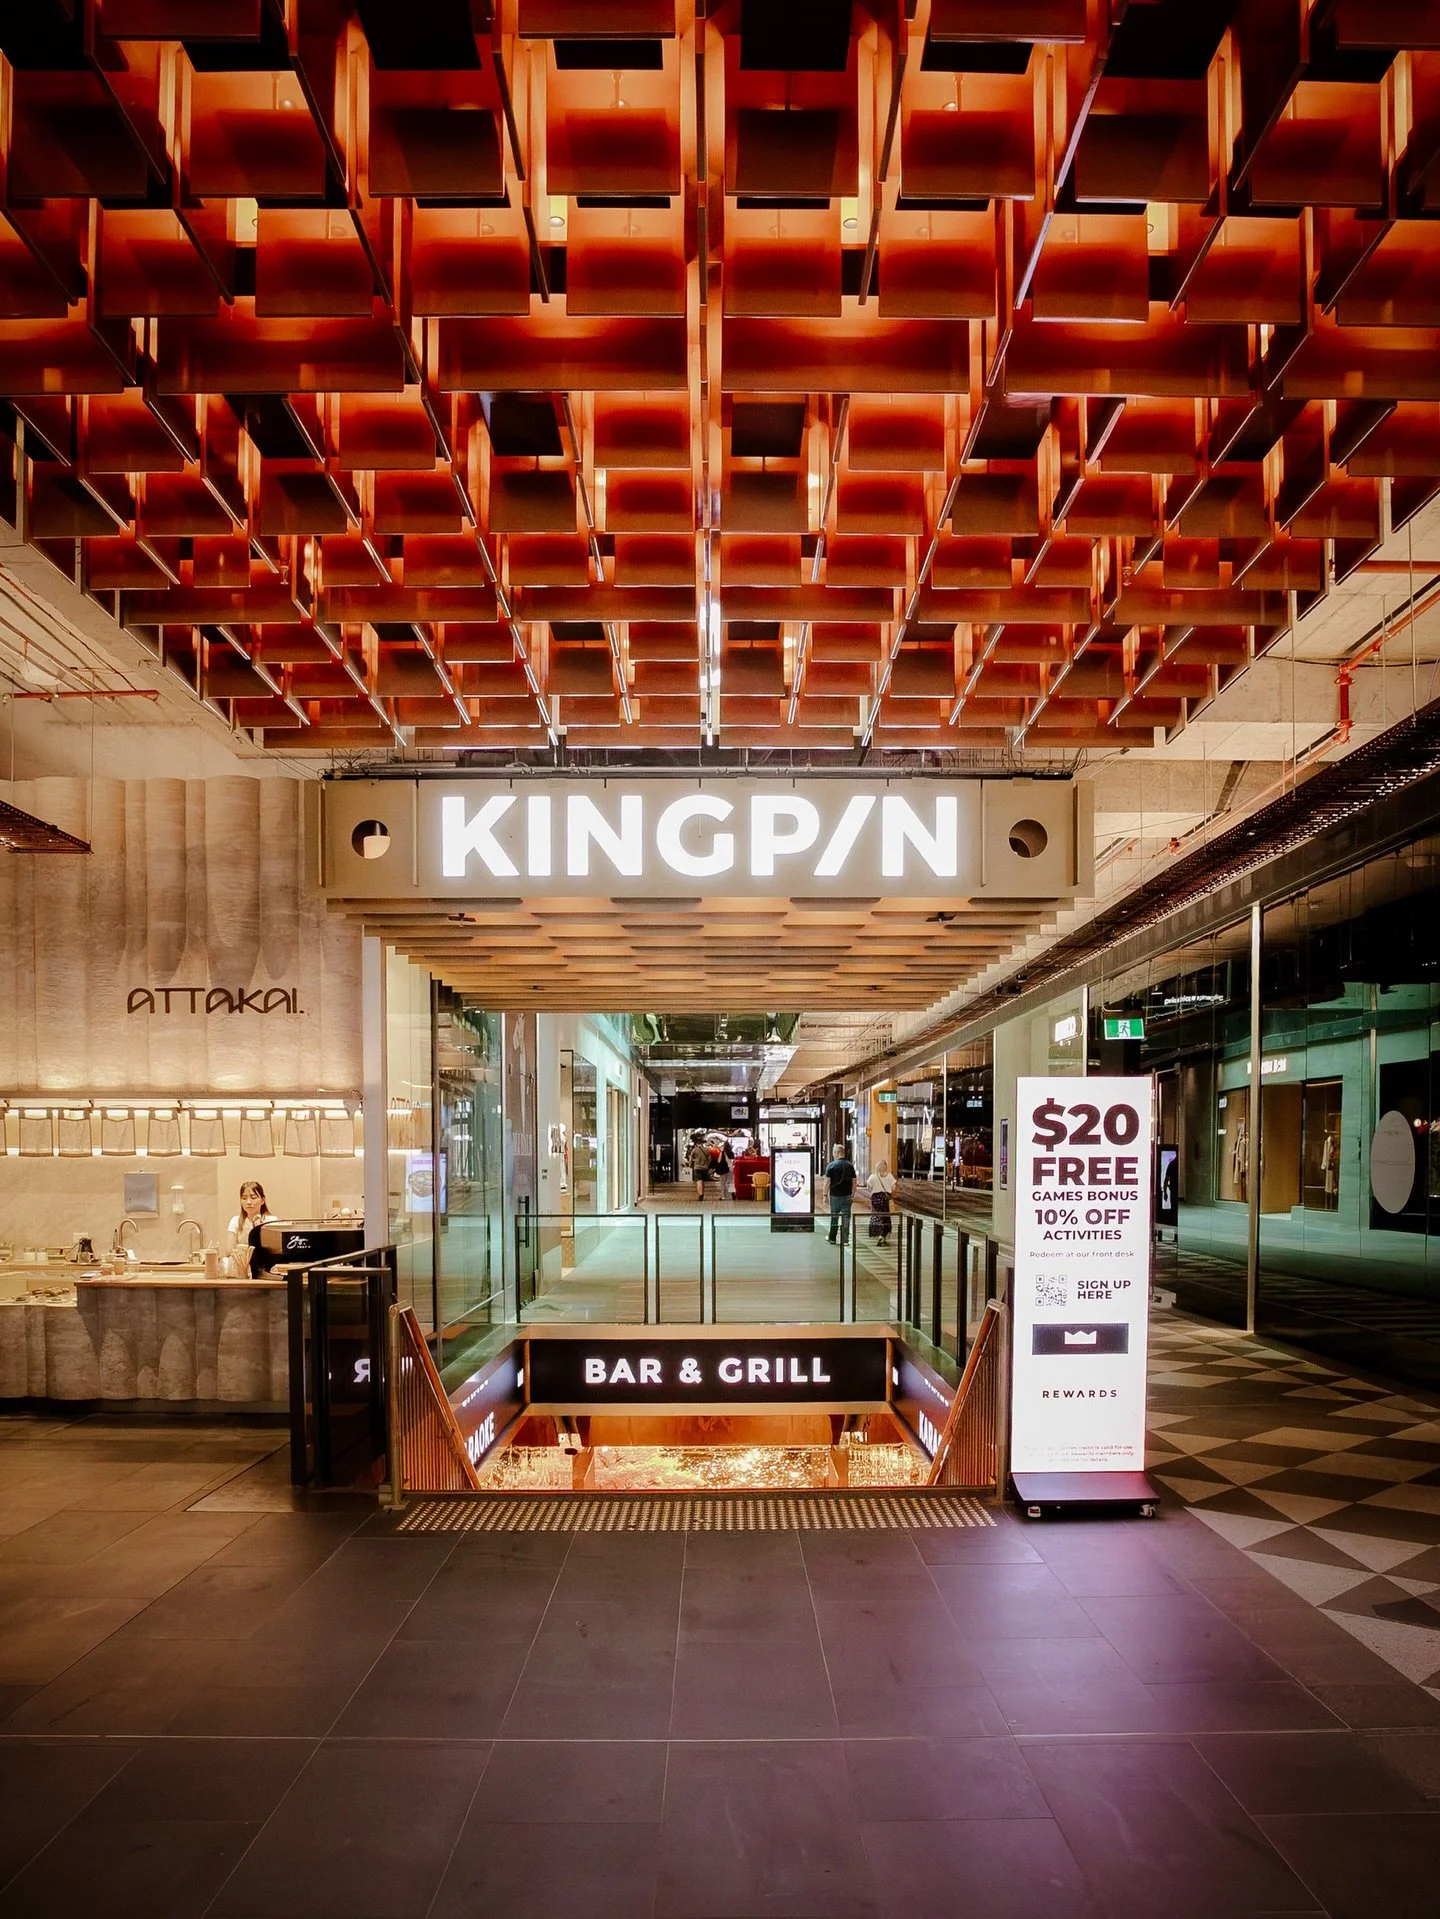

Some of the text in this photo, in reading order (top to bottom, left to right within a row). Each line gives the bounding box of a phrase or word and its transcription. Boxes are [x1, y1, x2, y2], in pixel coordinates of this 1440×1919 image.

[1032, 1098, 1139, 1152] $20
[1032, 1157, 1138, 1186] FREE
[1032, 1190, 1138, 1201] GAMES BONUS
[1035, 1208, 1130, 1225] 10% OFF
[1043, 1230, 1122, 1241] ACTIVITIES
[1077, 1280, 1131, 1290] SIGN UP
[1077, 1290, 1112, 1300] HERE
[585, 1357, 831, 1384] BAR & GRILL
[1042, 1390, 1118, 1399] REWARDS
